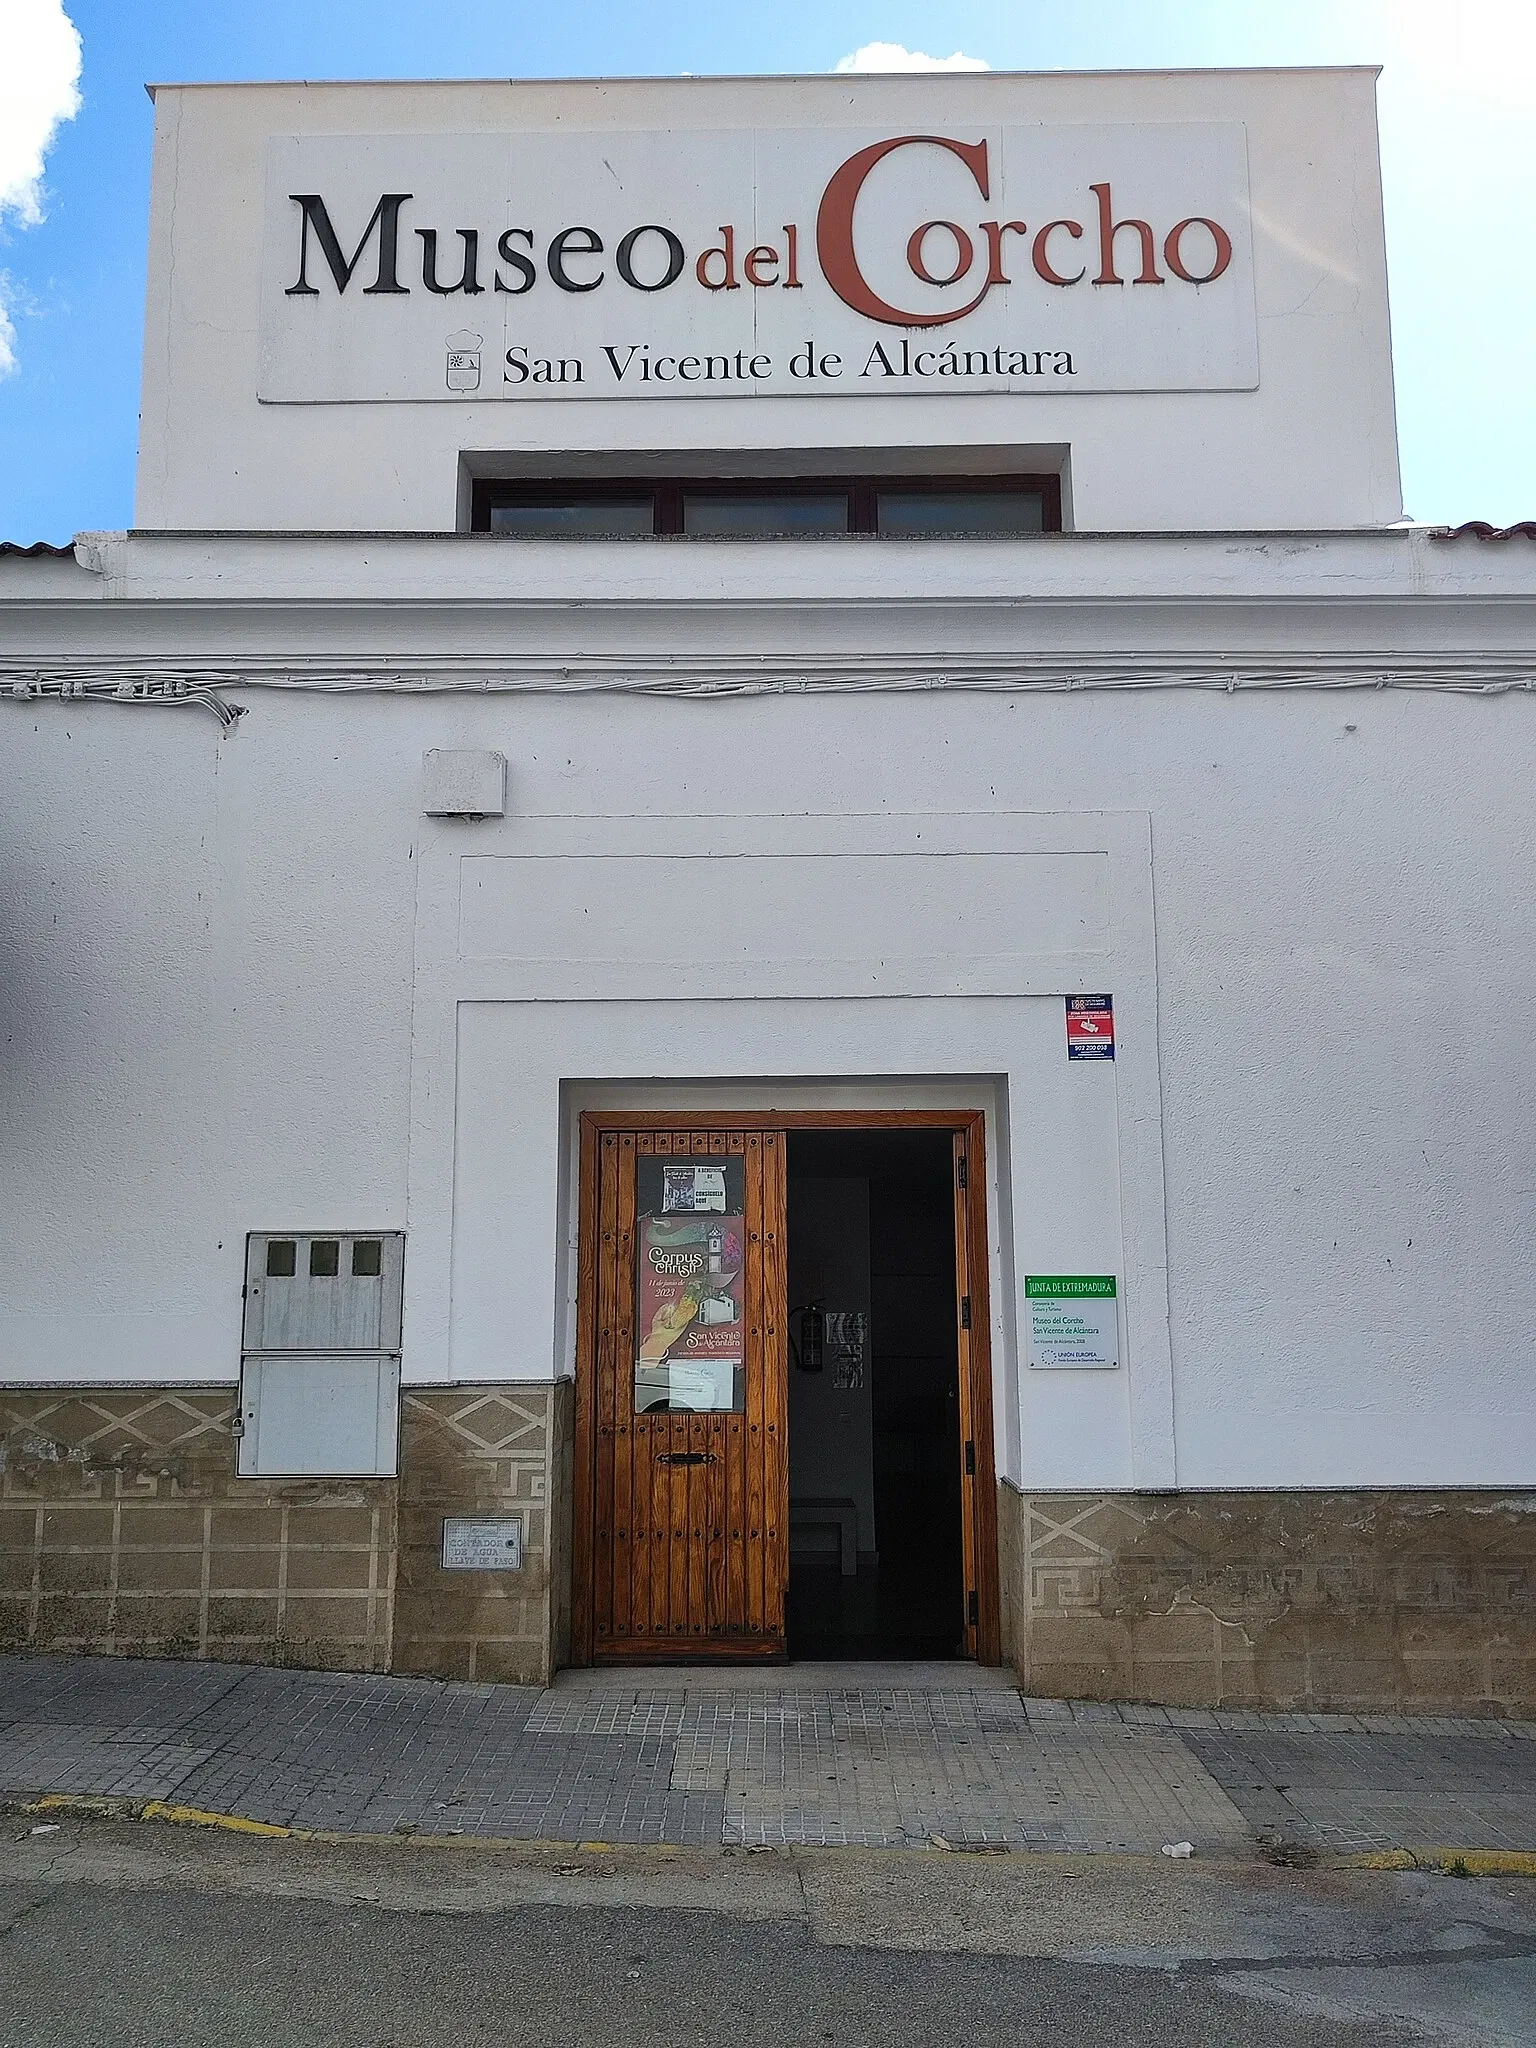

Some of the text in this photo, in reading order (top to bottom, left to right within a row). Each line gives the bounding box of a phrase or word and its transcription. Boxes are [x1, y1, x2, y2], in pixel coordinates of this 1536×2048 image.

[285, 136, 1233, 327] Museo del Corcho
[504, 339, 1078, 383] San Vicente de Alcántara
[648, 1247, 703, 1268] Corpus
[1029, 1282, 1112, 1294] JUNTA DE EXTREMADURA
[654, 1289, 676, 1297] 2023
[1052, 1316, 1061, 1324] del
[1062, 1316, 1084, 1324] Corcho
[1073, 1326, 1099, 1334] Alcántara
[454, 1548, 499, 1556] DE AGUA
[494, 1557, 513, 1565] PASO
